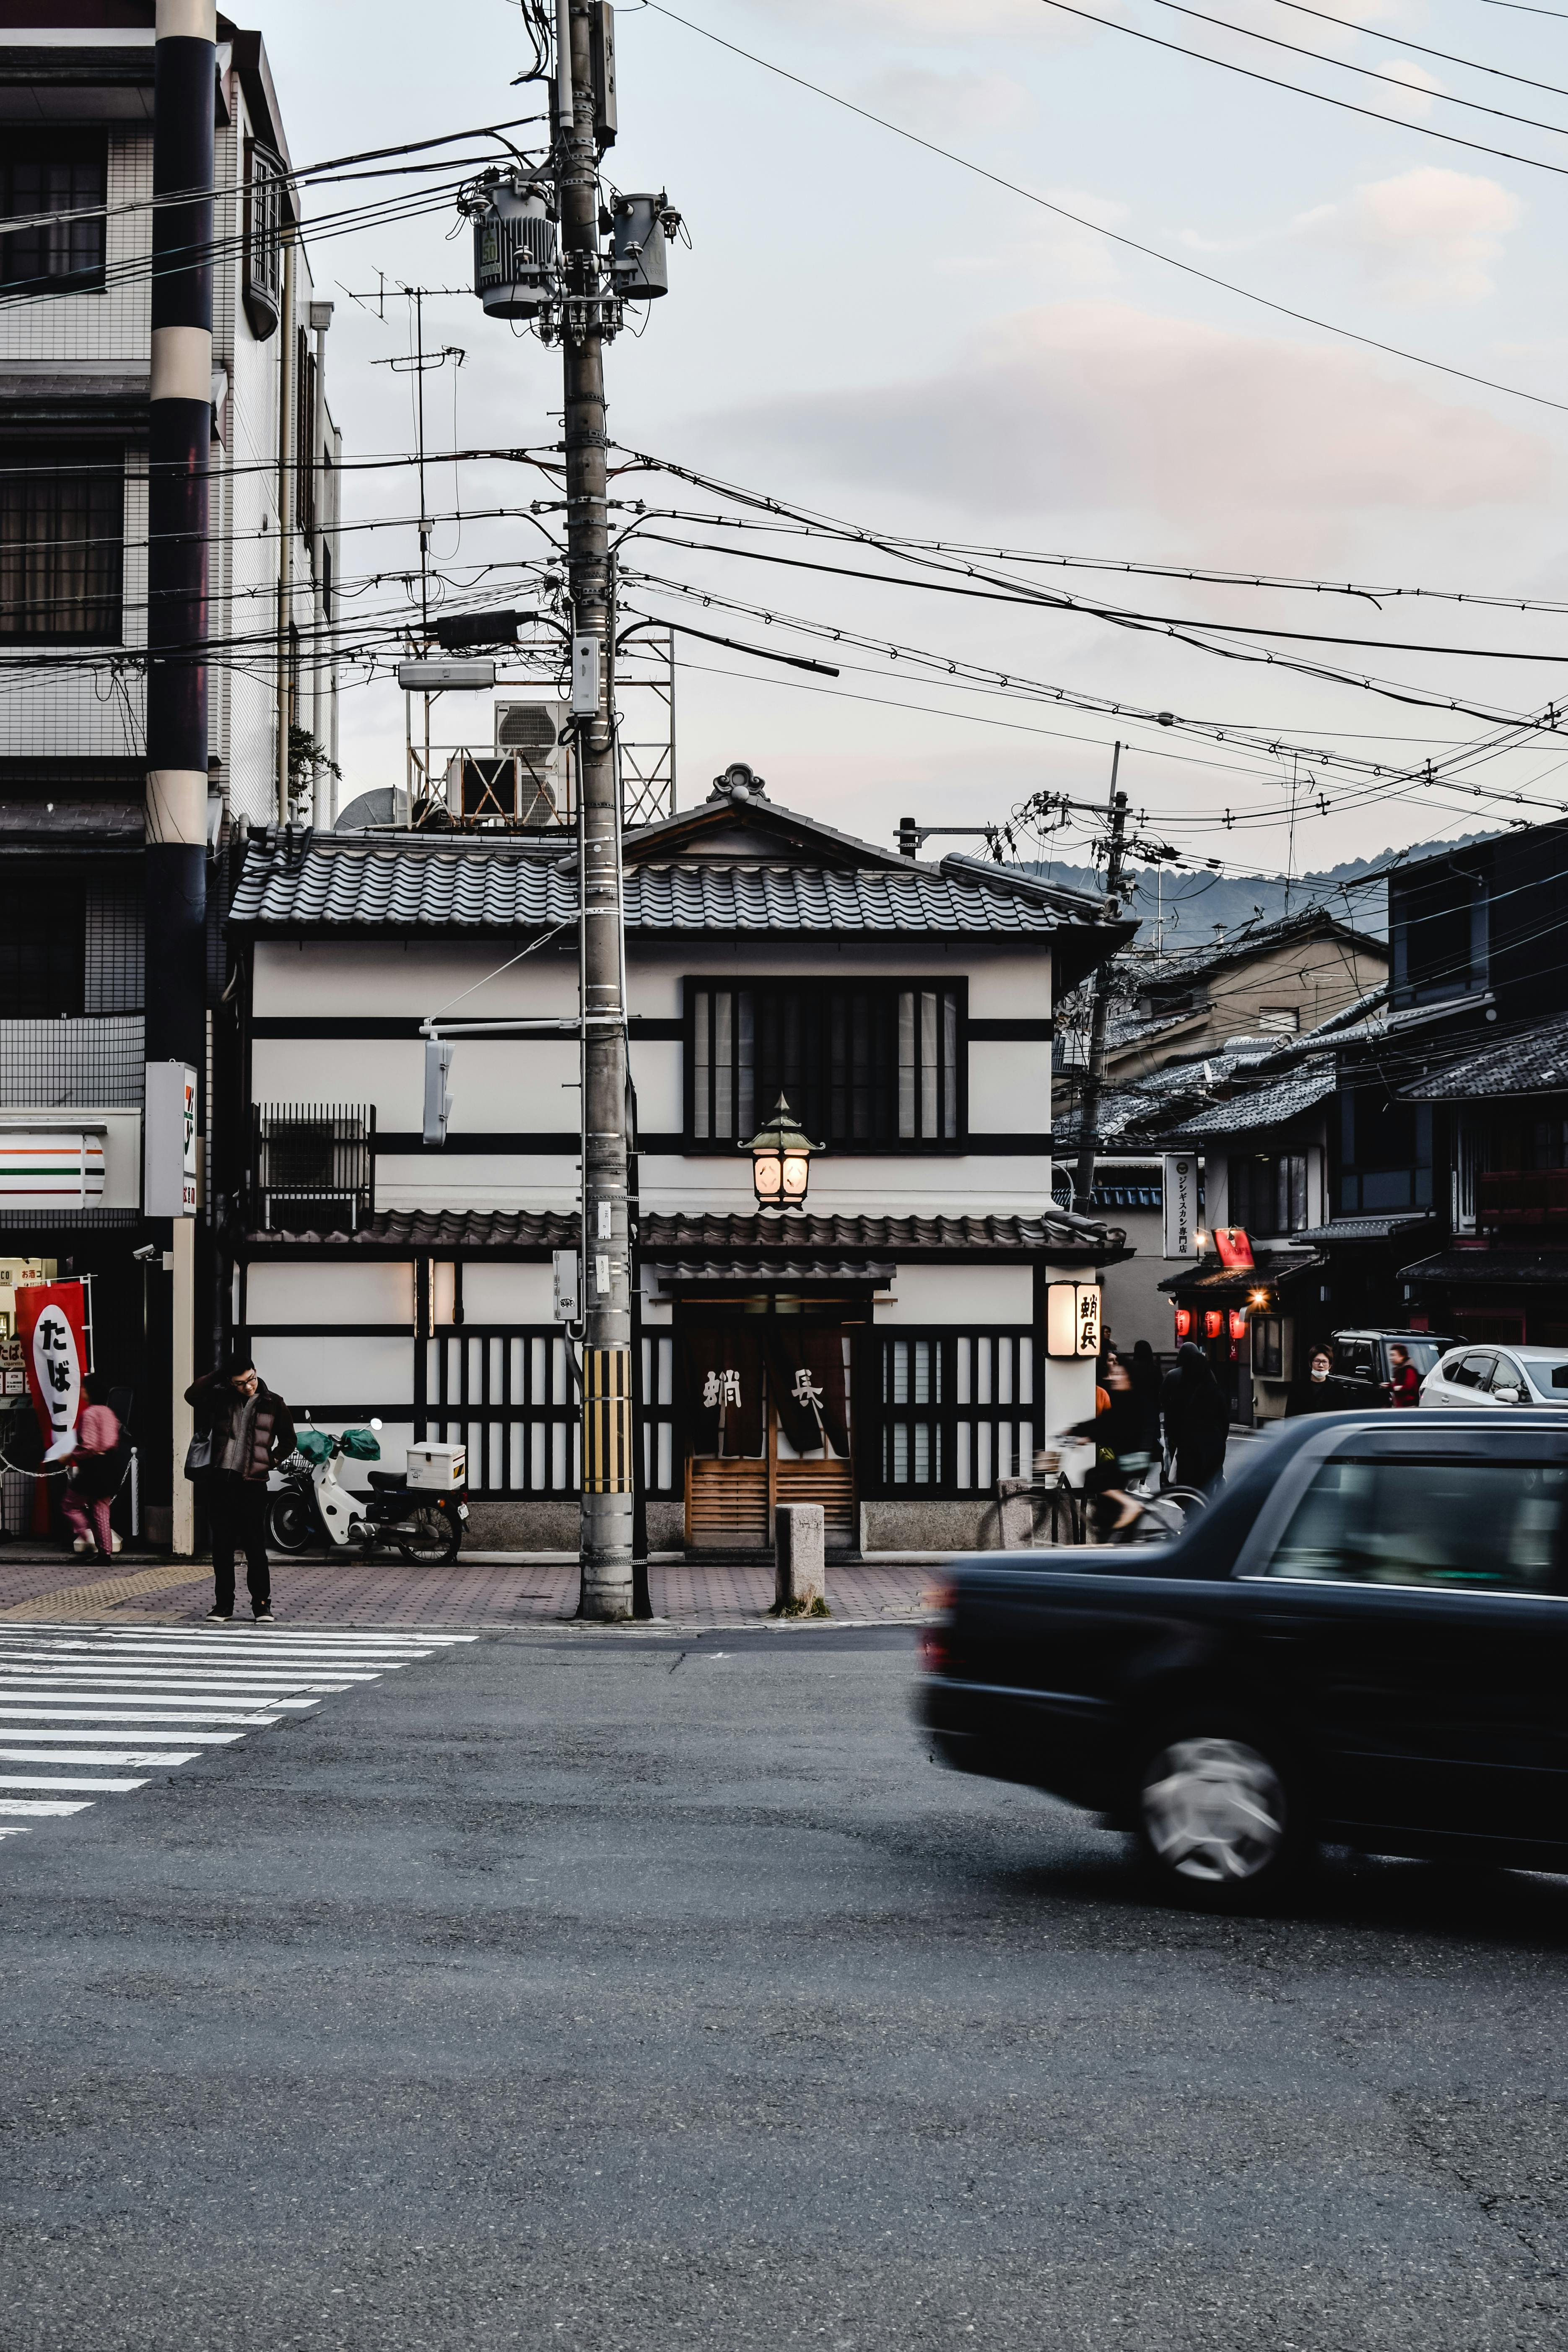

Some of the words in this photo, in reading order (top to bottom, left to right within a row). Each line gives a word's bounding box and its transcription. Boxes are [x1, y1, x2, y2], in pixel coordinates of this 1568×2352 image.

[483, 244, 496, 262] 50
[1179, 1176, 1187, 1253] ジンギスカン専門店
[1080, 1294, 1097, 1350] 蛸長
[39, 1320, 70, 1432] たばこ
